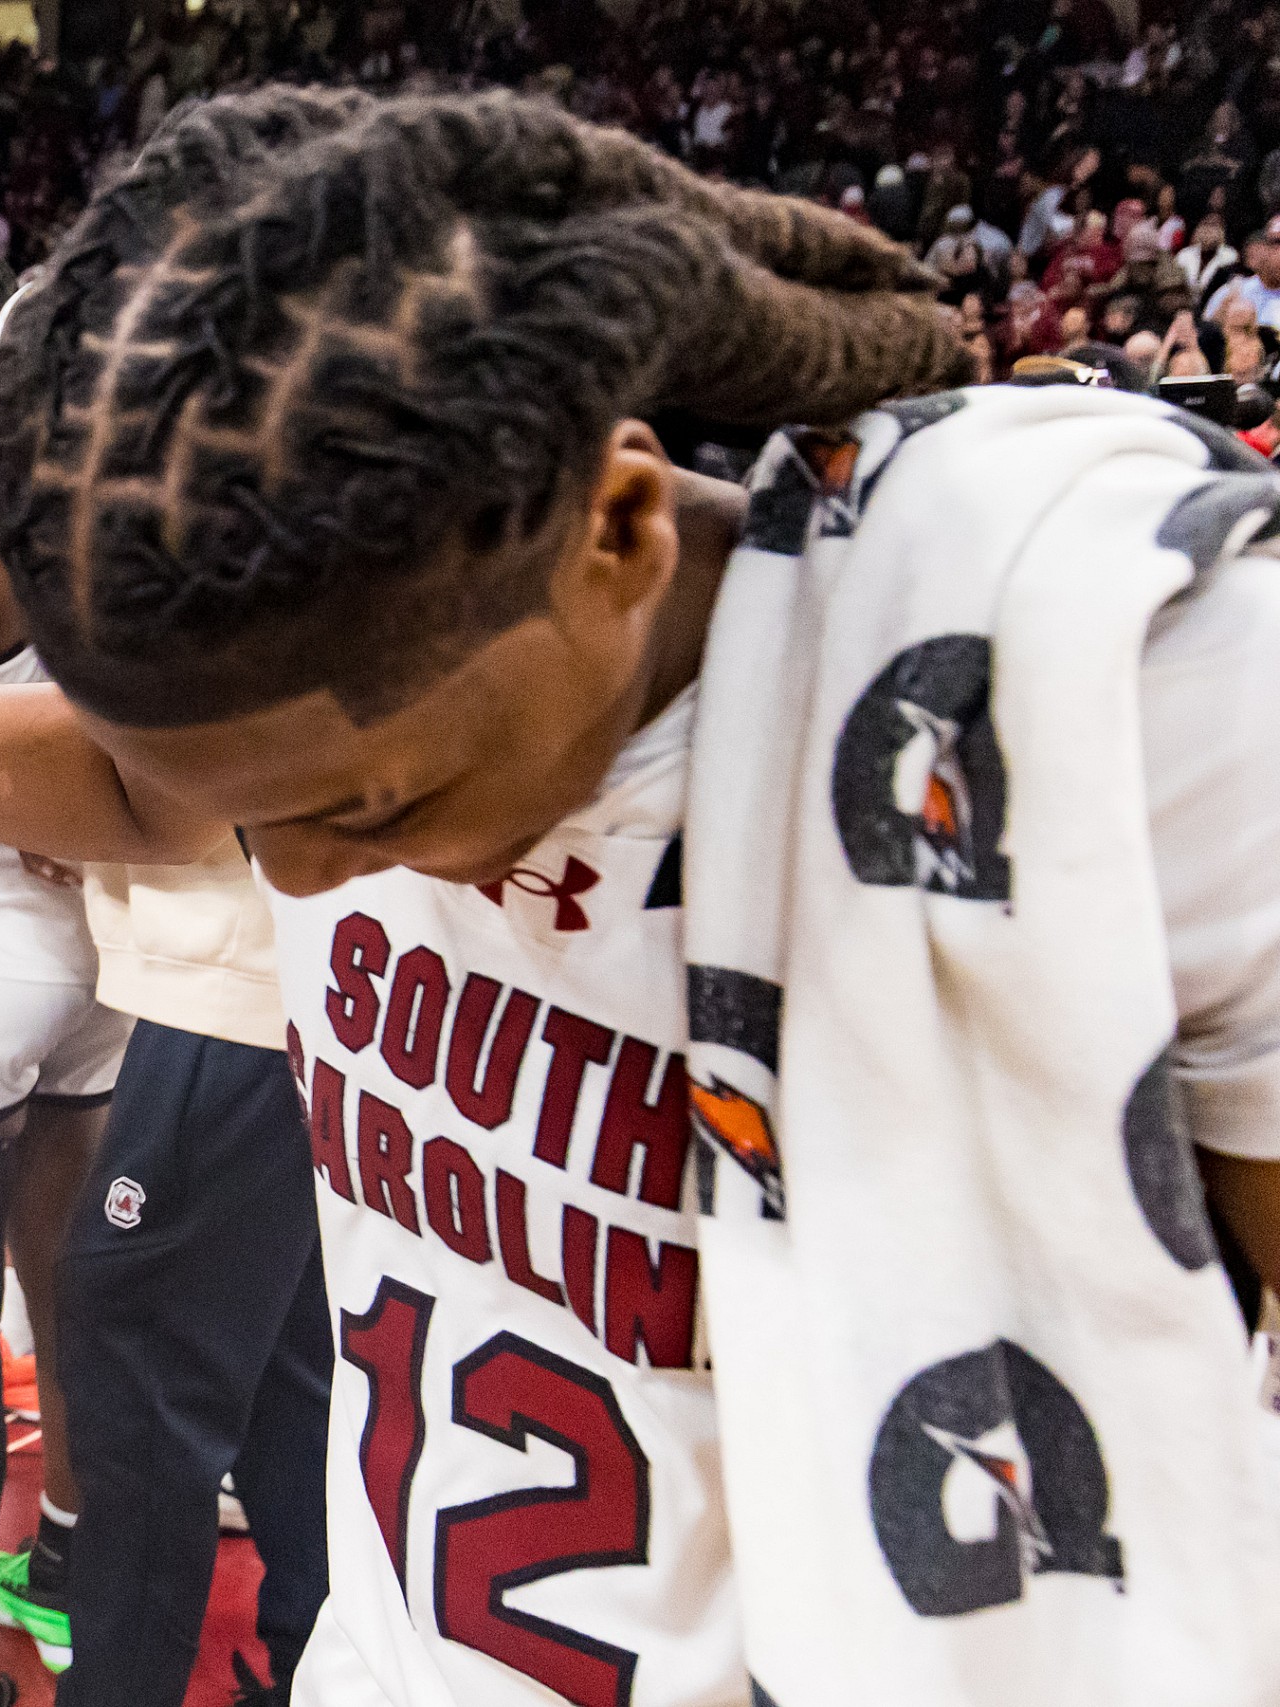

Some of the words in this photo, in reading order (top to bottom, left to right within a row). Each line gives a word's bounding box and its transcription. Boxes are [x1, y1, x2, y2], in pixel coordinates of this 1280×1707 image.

[287, 1019, 700, 1370] AROLIN
[325, 911, 691, 1212] SOUTH
[340, 1274, 650, 1707] 12
